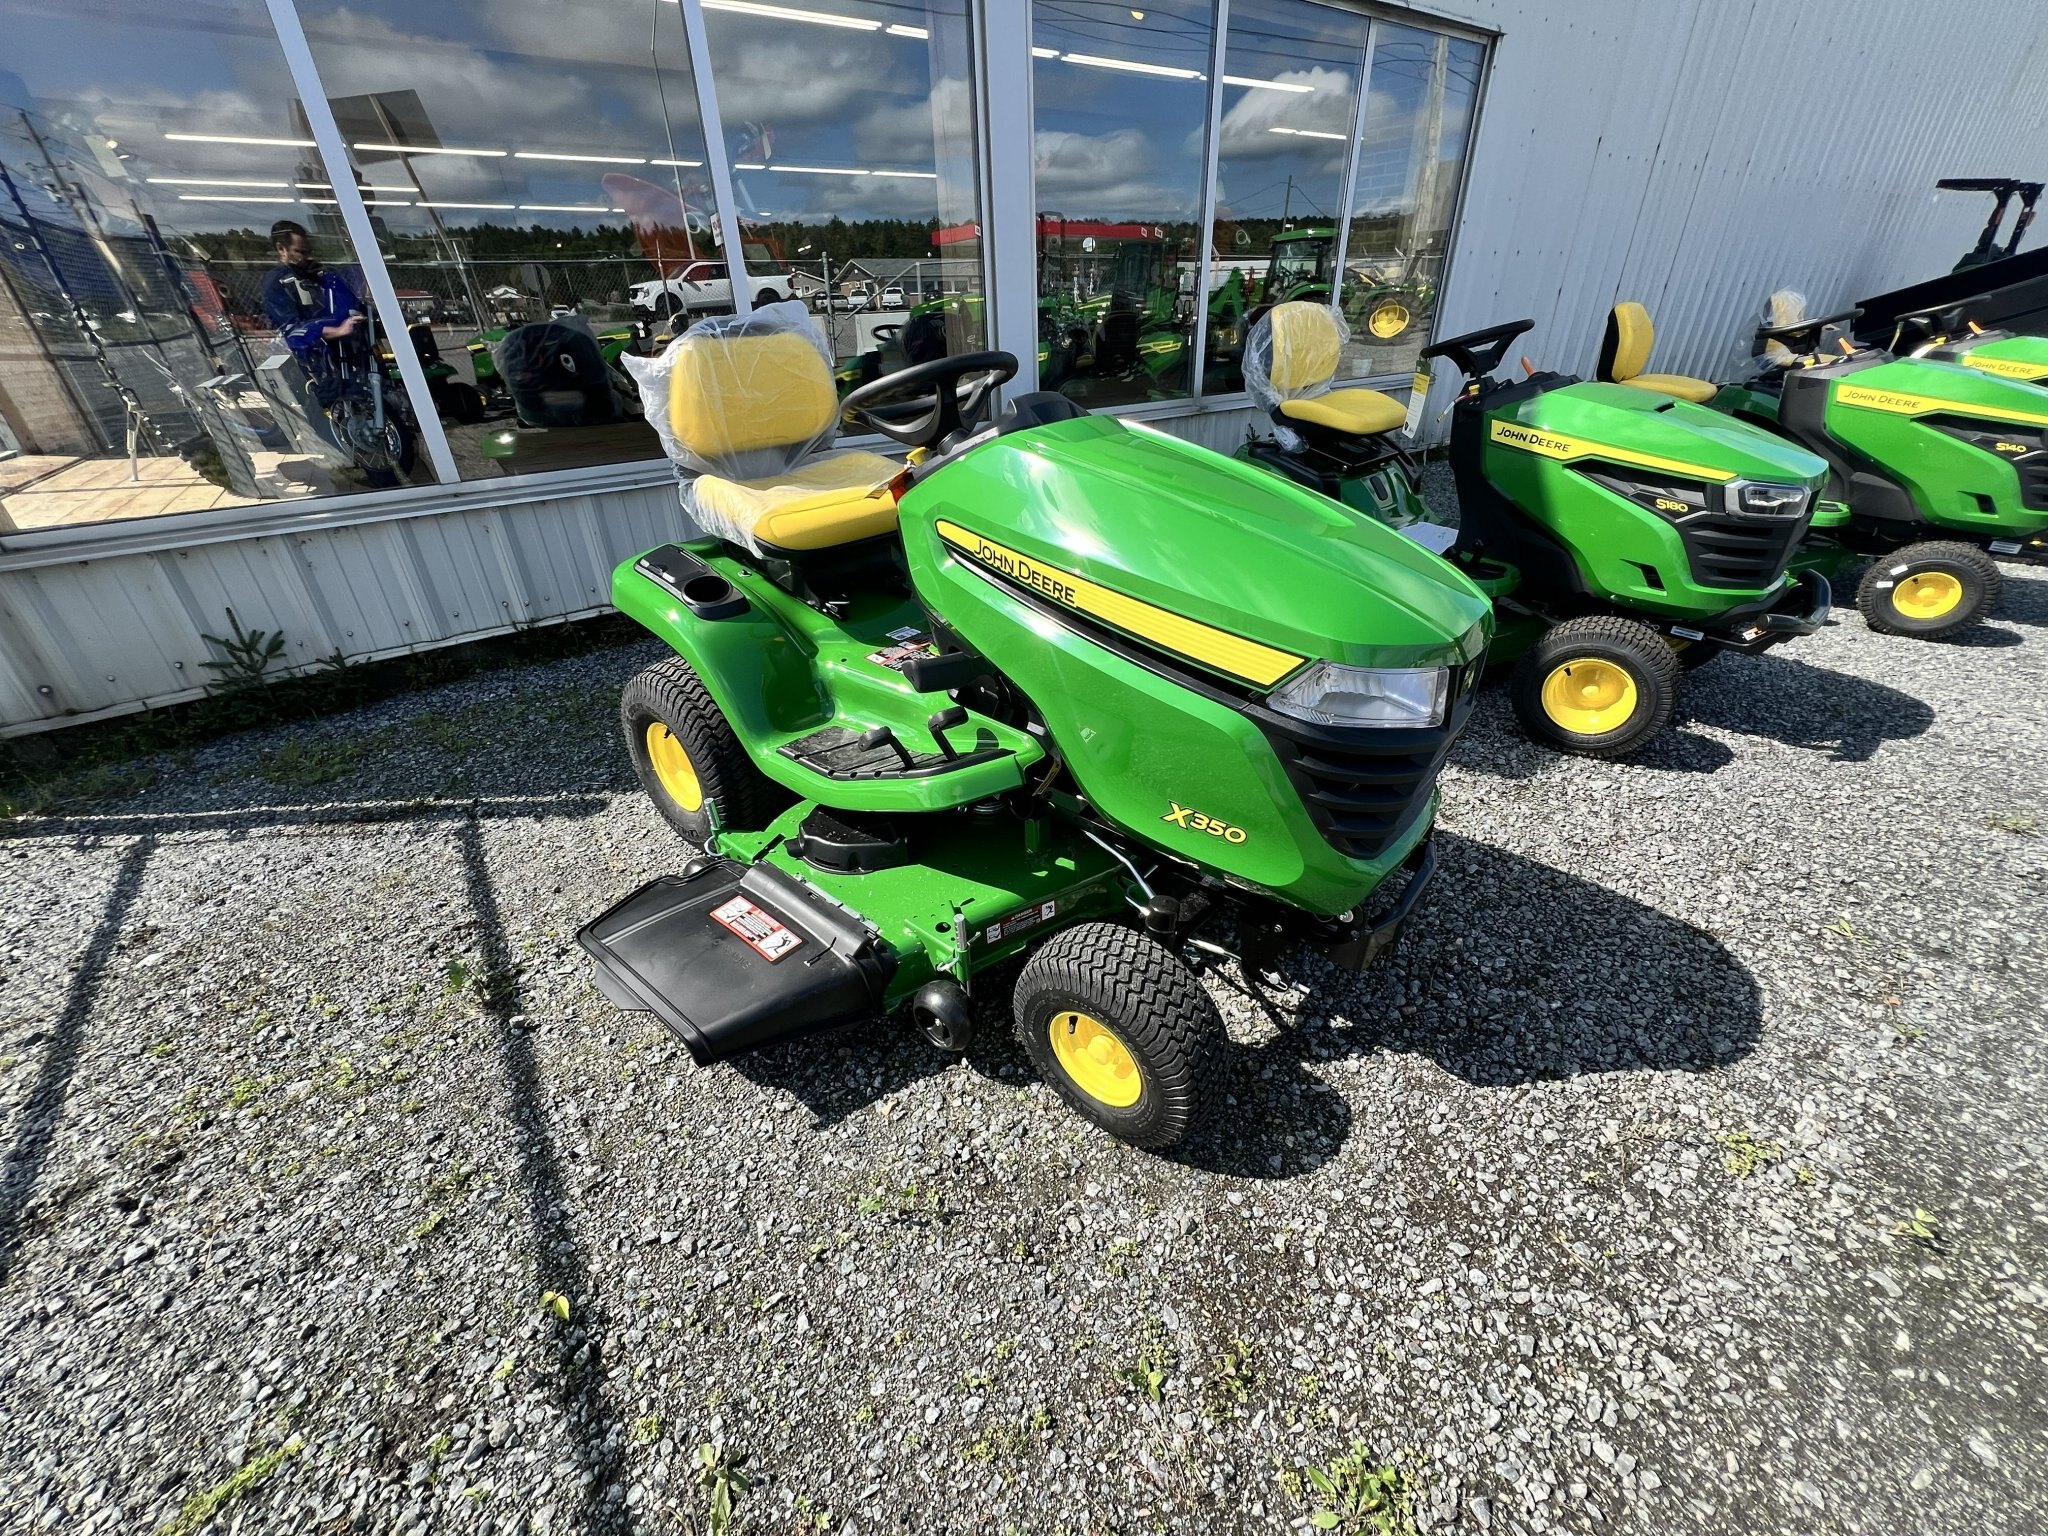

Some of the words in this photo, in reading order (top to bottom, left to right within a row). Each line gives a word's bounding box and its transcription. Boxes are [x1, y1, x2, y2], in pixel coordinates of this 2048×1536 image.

[1968, 360, 1996, 369] JOHN
[1998, 364, 2034, 375] DEERE
[1844, 390, 1876, 402] JOHN
[1878, 395, 1921, 409] DEERE
[1496, 426, 1528, 442] JOHN
[1529, 434, 1572, 452] DEERE
[1995, 442, 2027, 453] S140
[1655, 498, 1689, 513] S180
[973, 539, 1014, 574] JOHN
[1018, 559, 1076, 605] DEERE
[1160, 800, 1248, 844] X350
